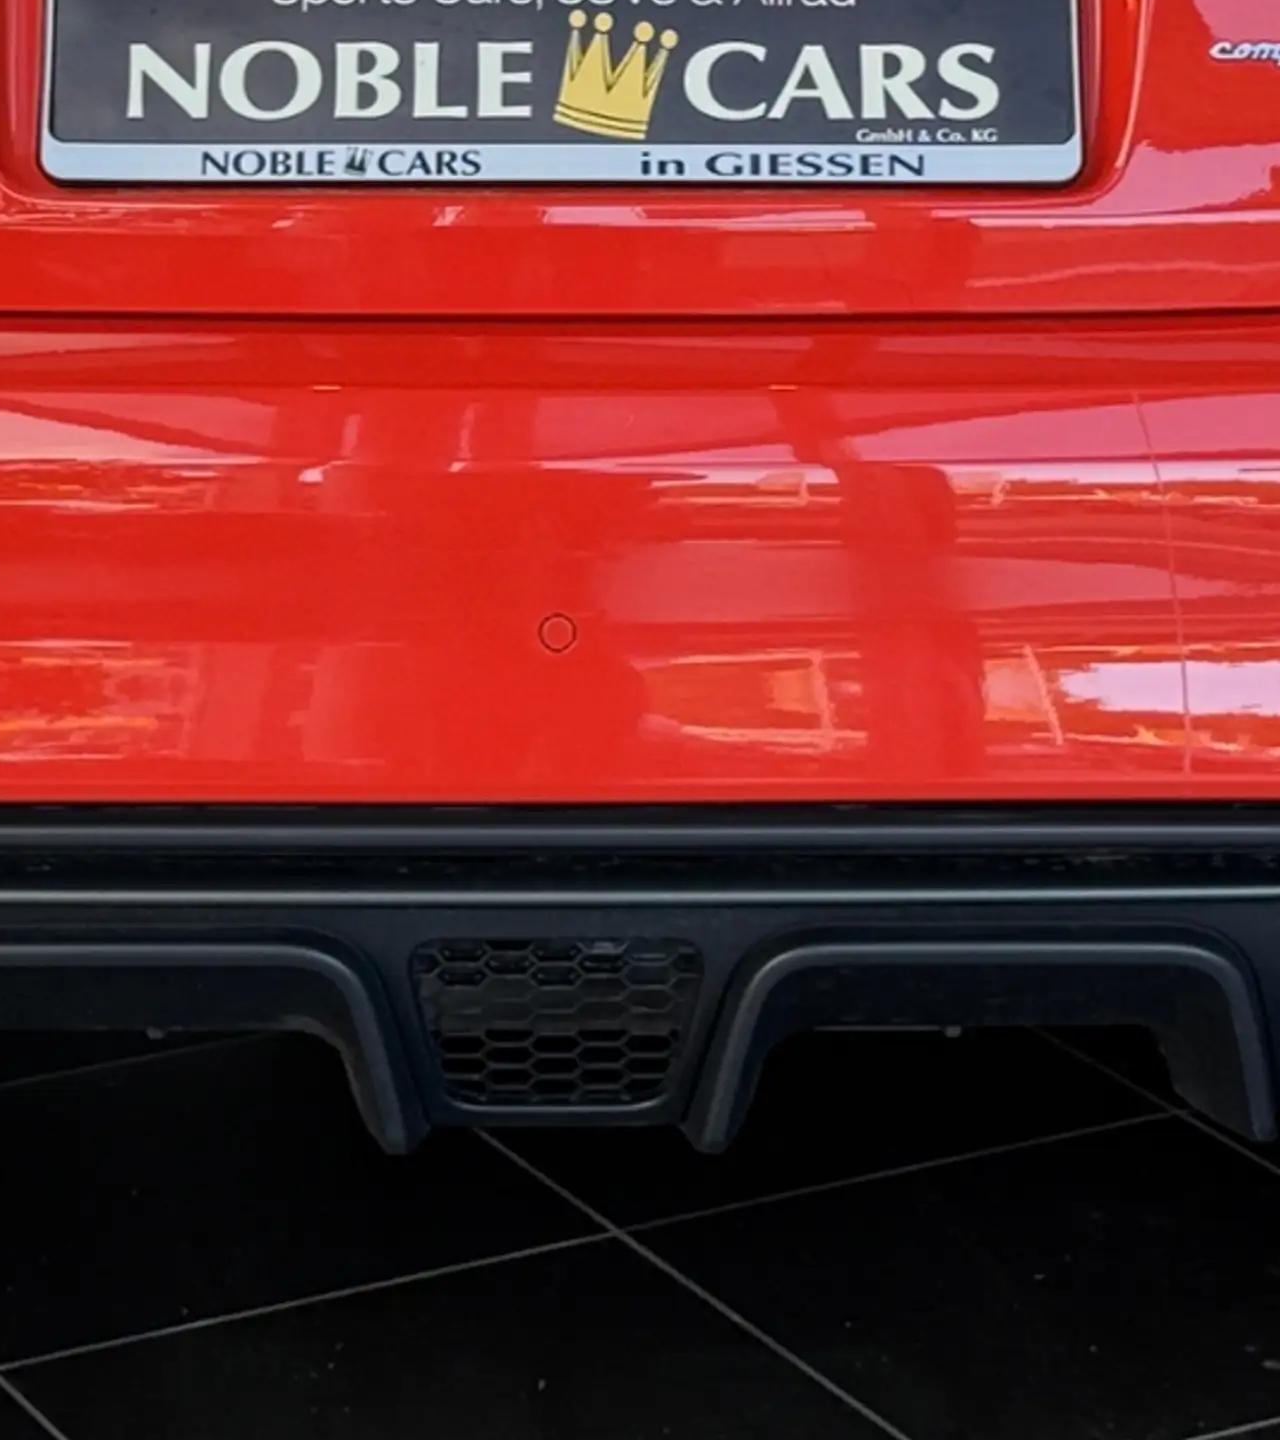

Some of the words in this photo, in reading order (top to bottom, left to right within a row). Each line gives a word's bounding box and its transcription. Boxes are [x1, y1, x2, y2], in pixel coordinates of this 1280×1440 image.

[126, 40, 534, 121] NOBLE
[682, 41, 1001, 121] CARS
[855, 127, 914, 143] GmbH
[917, 128, 932, 143] &
[936, 128, 967, 143] Co.
[971, 128, 999, 143] KG
[200, 149, 337, 177] NOBLE
[377, 149, 483, 177] CARS
[639, 151, 686, 176] in
[704, 152, 926, 177] GIESSEN
